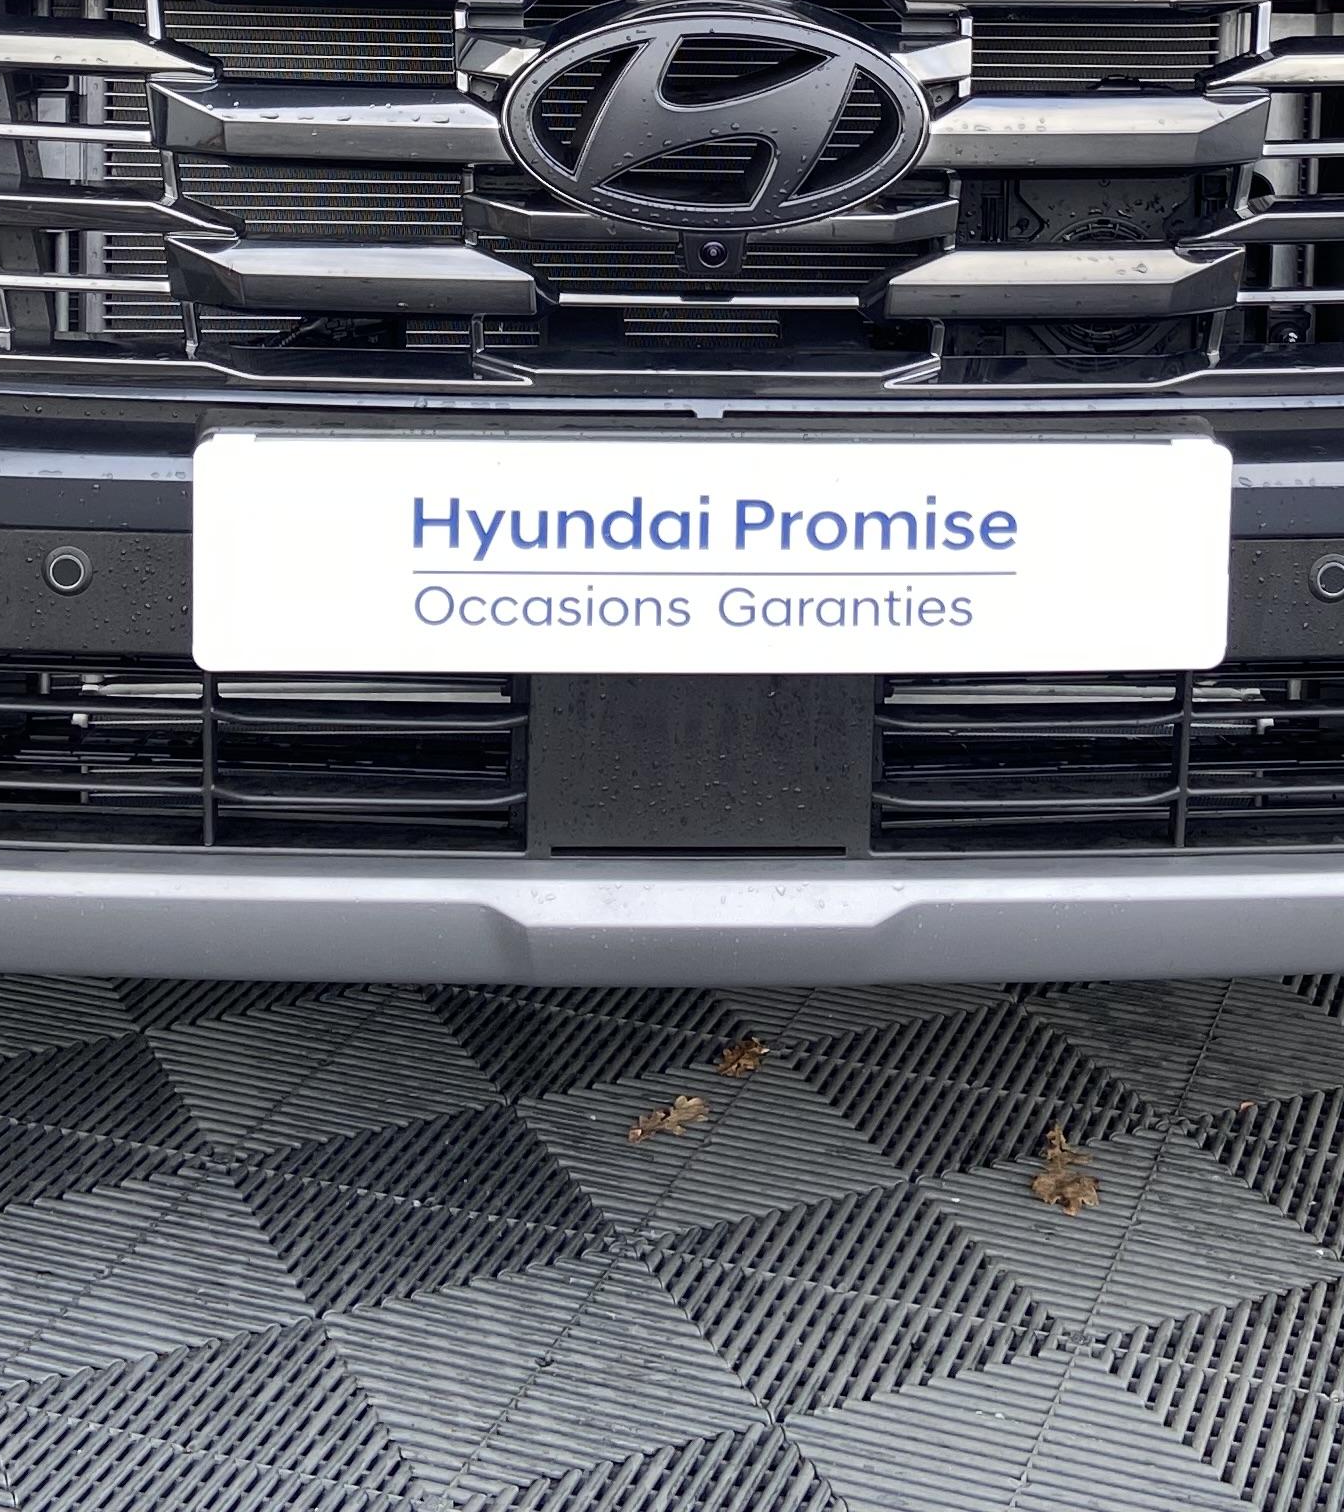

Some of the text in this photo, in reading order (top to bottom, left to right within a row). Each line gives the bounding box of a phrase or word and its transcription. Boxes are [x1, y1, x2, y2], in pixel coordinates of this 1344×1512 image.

[413, 495, 1018, 561] Hyundai Promise
[414, 585, 973, 627] Occasions Garanties
